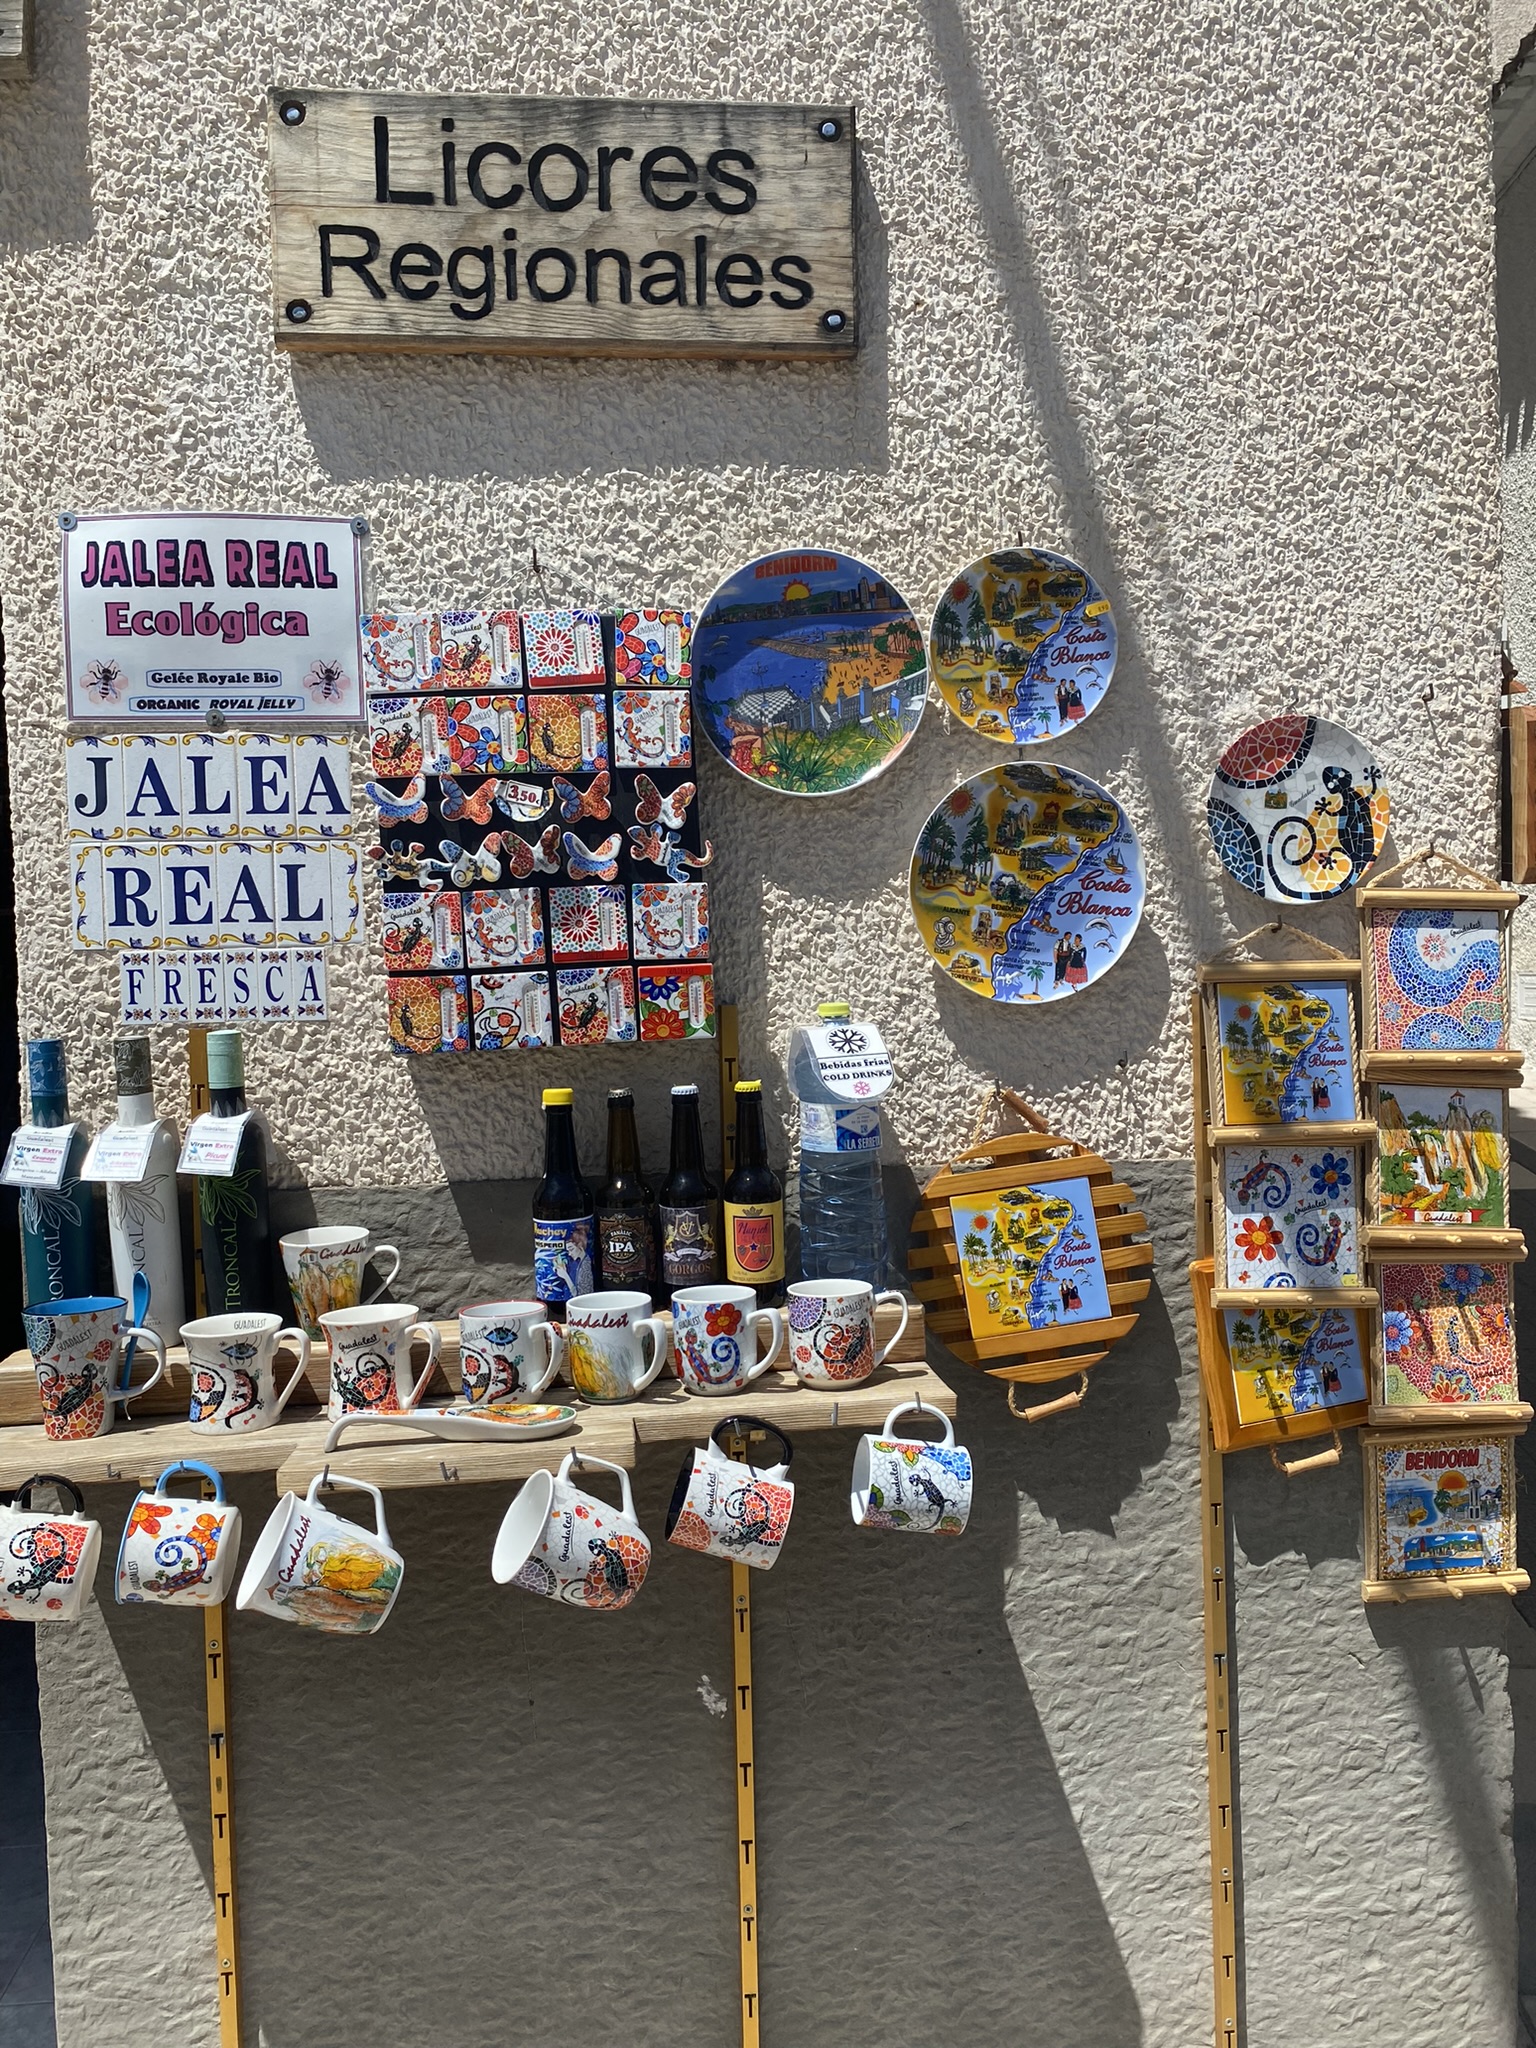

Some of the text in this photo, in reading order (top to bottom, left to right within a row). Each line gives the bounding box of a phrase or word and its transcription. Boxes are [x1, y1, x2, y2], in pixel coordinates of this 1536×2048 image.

[373, 115, 757, 215] Licores
[318, 224, 814, 321] Regionales
[81, 539, 338, 589] JALEA REAL
[754, 556, 838, 579] BENIDORM
[104, 602, 310, 644] Ecológica
[1063, 626, 1108, 645] Costa
[1051, 646, 1112, 667] Blanca
[151, 672, 279, 686] Gelée Royale Bio
[136, 699, 200, 710] ORGANIC
[209, 698, 254, 710] ROYAL
[74, 756, 351, 817] JALEA
[986, 847, 1020, 857] UADALEST
[1026, 873, 1045, 881] ALTEA
[1078, 869, 1133, 894] Costa
[106, 864, 324, 927] REAL
[1055, 891, 1133, 917] Blanca
[943, 906, 971, 916] ALICANTE
[991, 903, 1024, 913] BENIDORM
[126, 965, 322, 1005] FRESCA
[1317, 1039, 1345, 1053] Costa
[820, 1061, 862, 1070] Bebidas
[1308, 1053, 1348, 1069] Blanca
[823, 1070, 893, 1081] COLD DRINKS
[16, 1145, 63, 1155] Virgen Extra
[190, 1141, 213, 1149] Virgen
[204, 1152, 230, 1160] Picual
[128, 1228, 147, 1275] NCAL
[608, 1241, 636, 1253] IPA
[1061, 1238, 1093, 1253] Costa
[43, 1229, 65, 1301] RONCAL
[220, 1221, 241, 1311] TRONCAL
[668, 1263, 712, 1276] GORGOS
[1053, 1253, 1097, 1271] Blanca
[233, 1318, 267, 1331] GUADALEST
[567, 1309, 630, 1330] uadalest
[56, 1328, 93, 1352] GUADALEST
[338, 1333, 378, 1352] Guadalest
[1315, 1338, 1355, 1354] Blanca
[1404, 1448, 1481, 1472] BENIDORM
[888, 1459, 904, 1505] Guadalest
[704, 1472, 718, 1518] Guadalest
[558, 1510, 574, 1563] Guadalest
[278, 1514, 312, 1584] Guadalest
